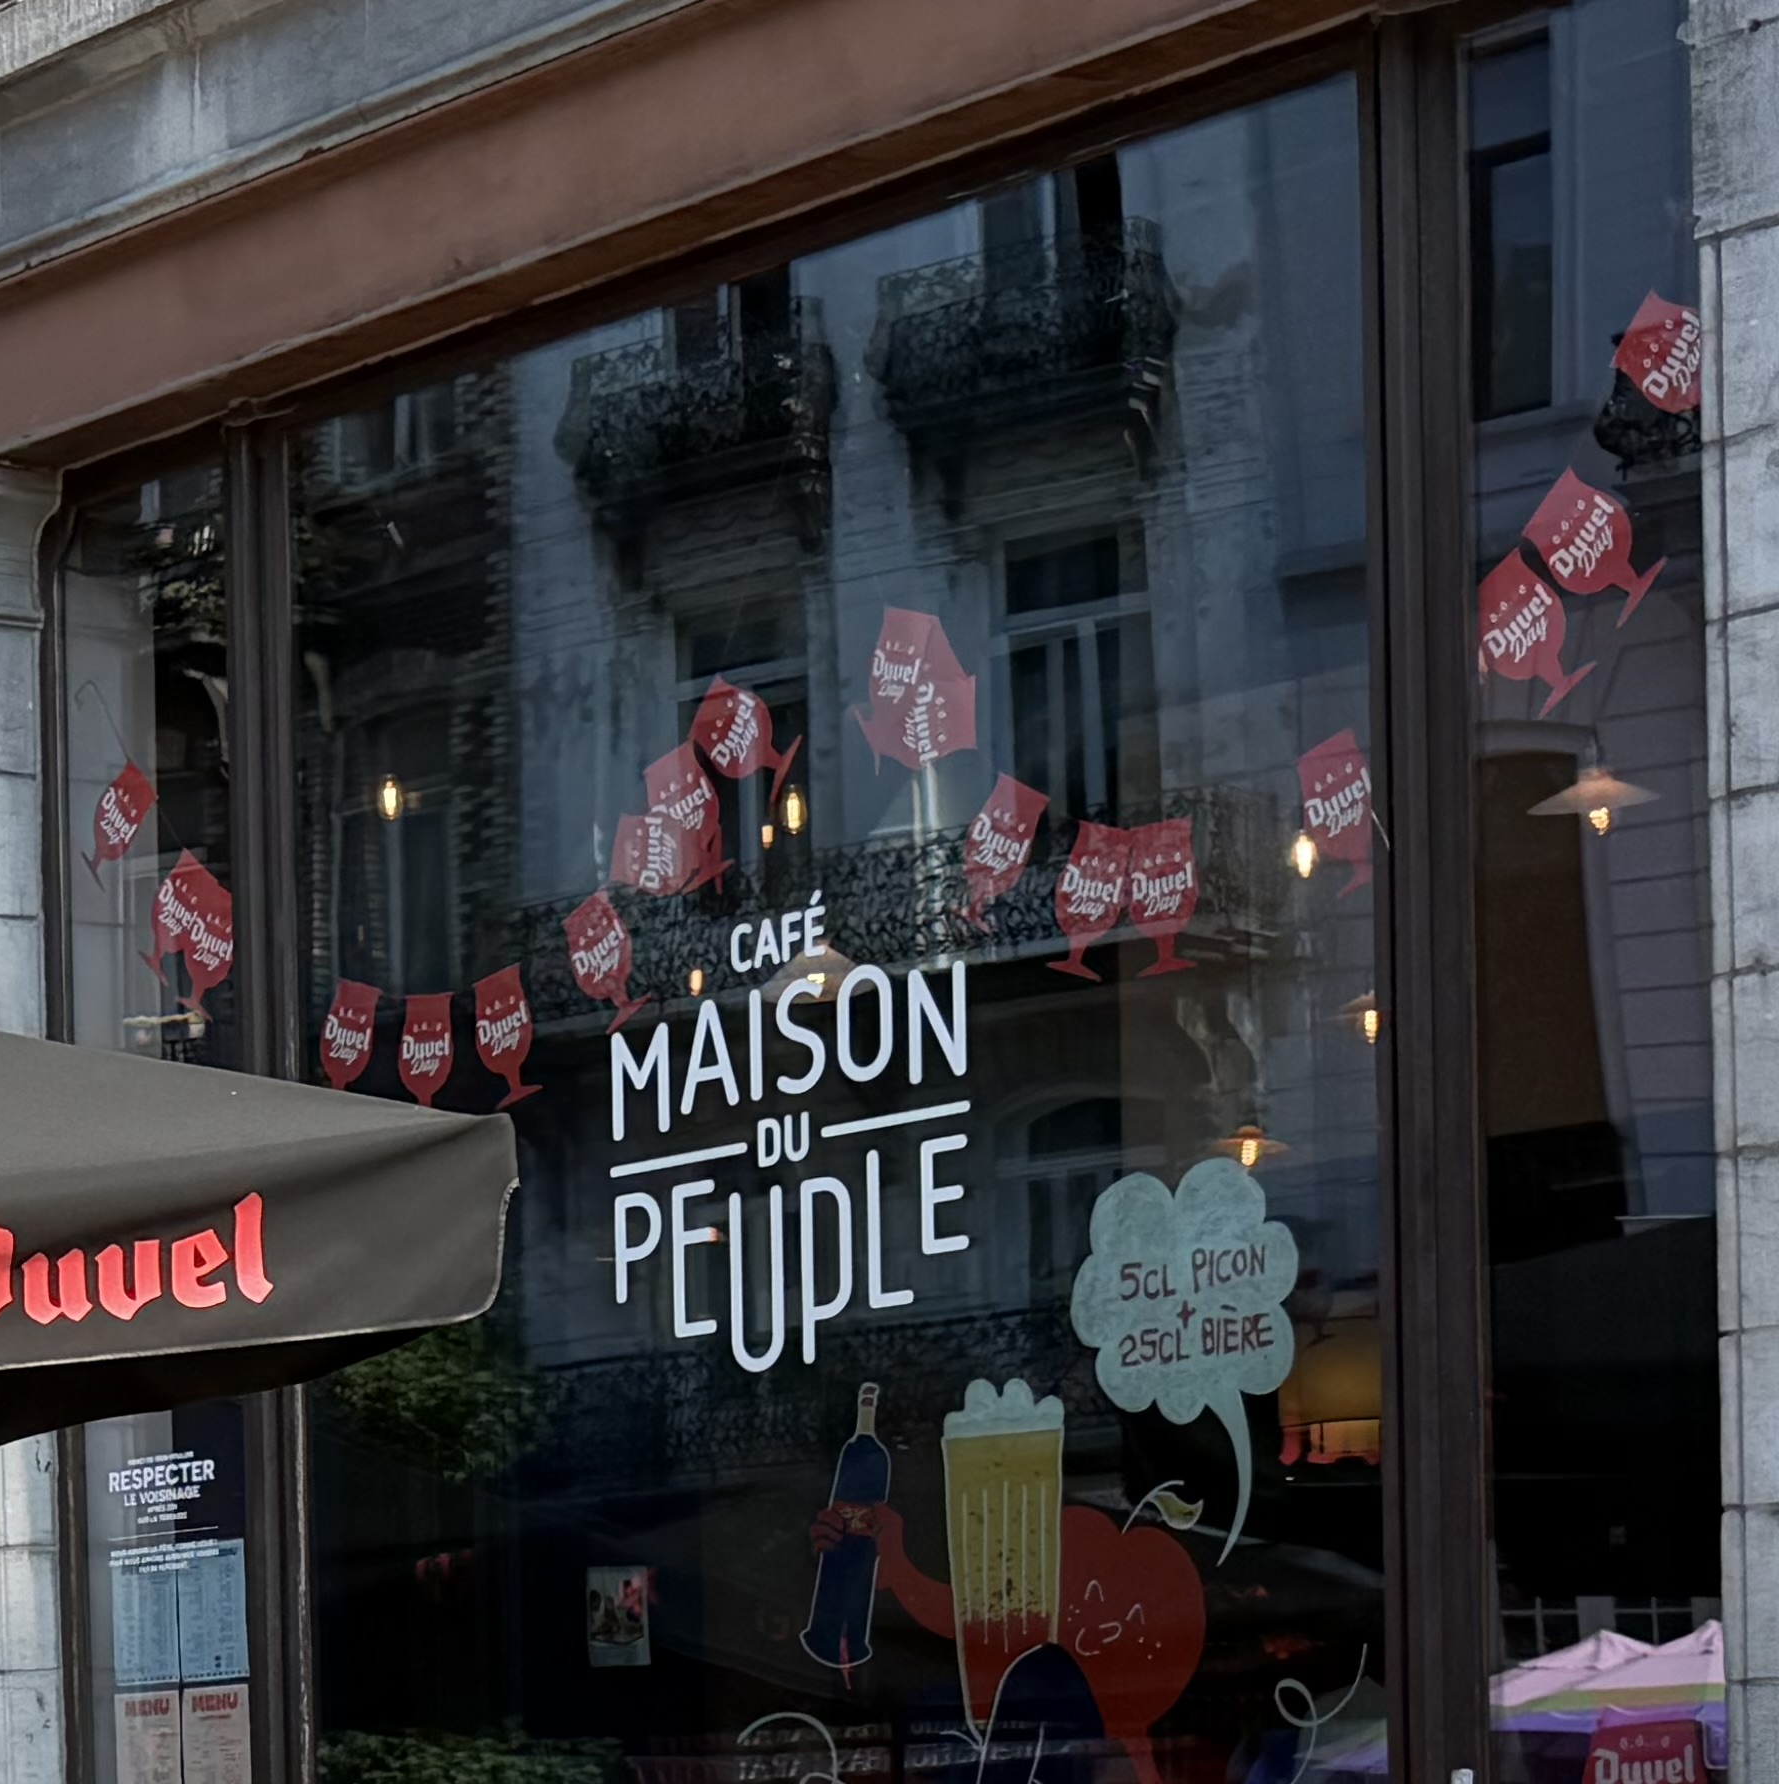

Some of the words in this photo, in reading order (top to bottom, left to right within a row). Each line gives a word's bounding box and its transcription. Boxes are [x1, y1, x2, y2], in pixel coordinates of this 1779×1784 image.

[1672, 338, 1701, 395] Da
[730, 889, 826, 973] CAFÉ
[1067, 897, 1105, 921] Day
[1143, 892, 1182, 917] Day
[611, 959, 967, 1142] MAISON
[757, 1111, 810, 1167] DU
[614, 1133, 970, 1373] PEUPLE
[1119, 1262, 1176, 1301] 5CL
[1191, 1244, 1266, 1293] PICON
[1119, 1327, 1190, 1368] 25CL
[1201, 1304, 1275, 1356] BIÈRE
[108, 1459, 216, 1493] RESPECTER
[123, 1492, 138, 1507] LE
[139, 1485, 201, 1504] VOISINAGE
[125, 1697, 170, 1718] MENU
[191, 1692, 239, 1713] MENU
